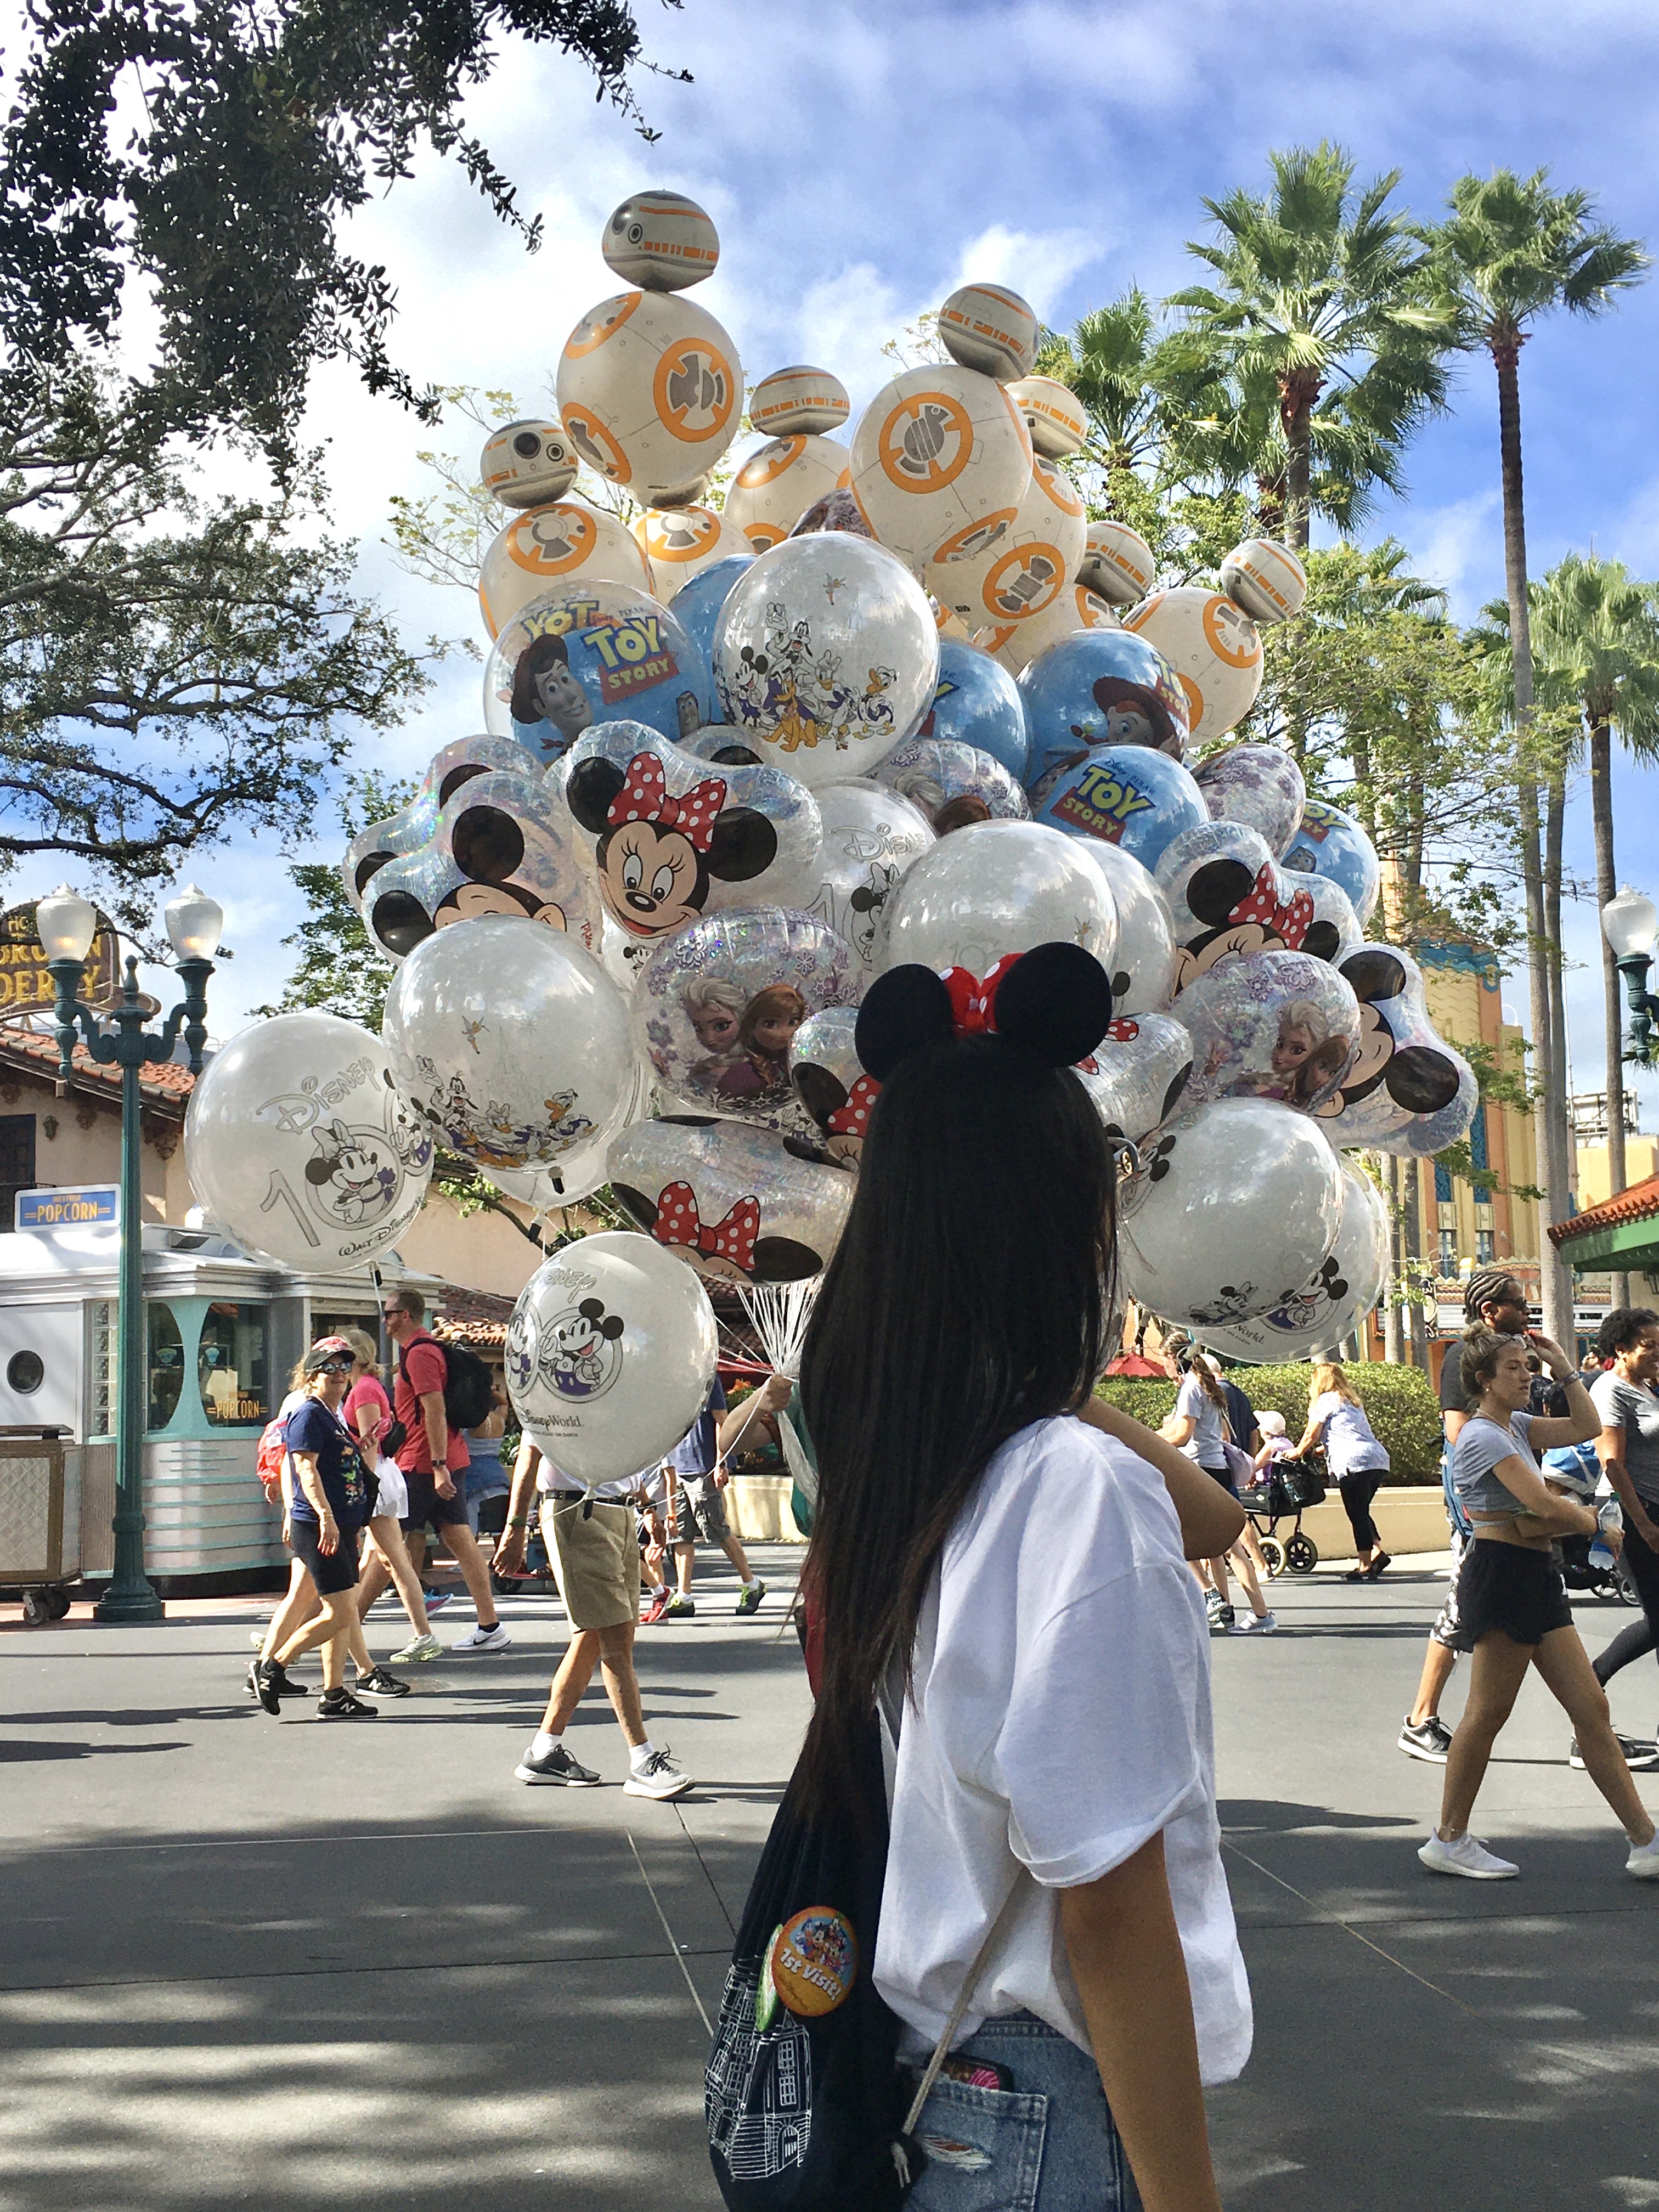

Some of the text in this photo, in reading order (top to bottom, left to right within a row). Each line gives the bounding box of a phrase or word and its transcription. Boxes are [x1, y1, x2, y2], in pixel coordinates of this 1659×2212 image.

[619, 606, 645, 617] PIXAR
[582, 617, 662, 670] TOY
[607, 658, 669, 689] STORY
[1076, 765, 1153, 821] TOY
[1129, 775, 1156, 795] PIXAR
[1063, 797, 1118, 836] STORY
[1303, 803, 1350, 828] OY
[37, 1201, 98, 1223] POPCORN
[217, 1400, 259, 1420] POPCORN
[780, 1948, 803, 1974] 1st
[802, 1964, 842, 2001] Visit!
